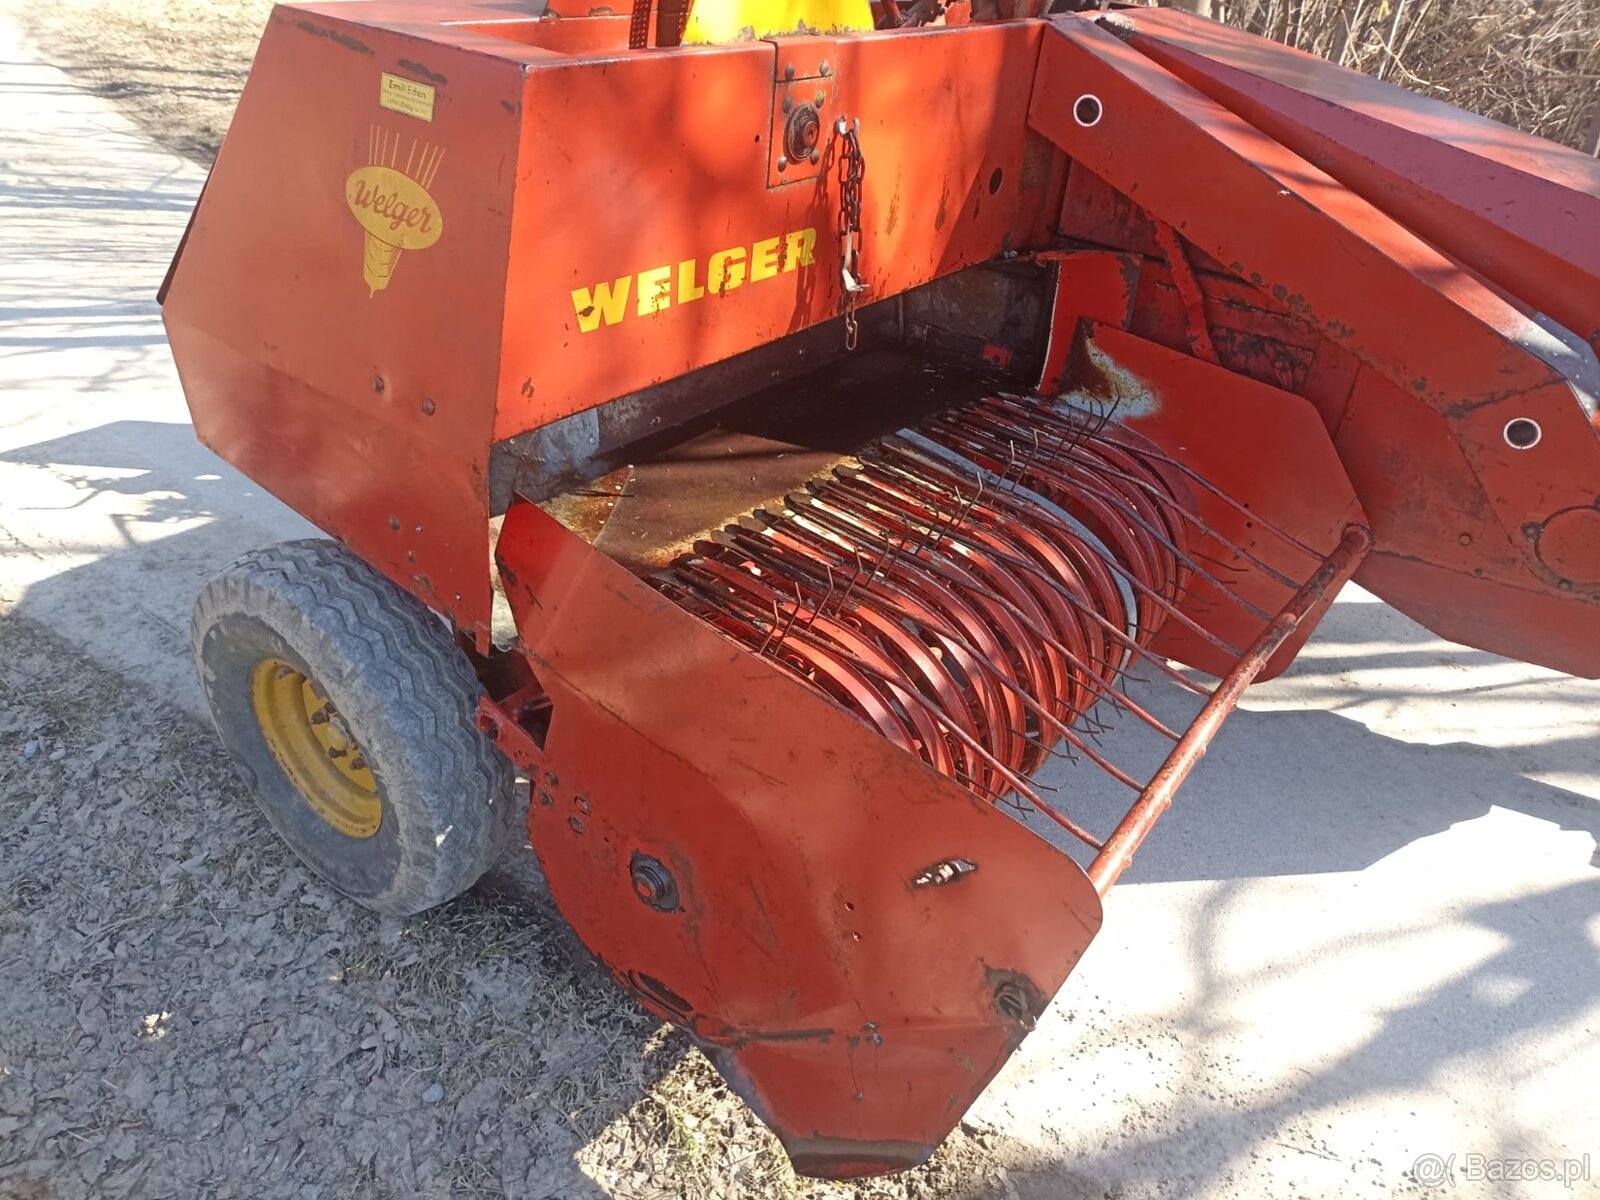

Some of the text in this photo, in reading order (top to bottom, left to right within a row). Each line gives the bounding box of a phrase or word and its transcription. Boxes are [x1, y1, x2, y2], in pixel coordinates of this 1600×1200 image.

[389, 79, 405, 91] Emil
[355, 180, 431, 233] Welger
[571, 228, 817, 333] WELGER
